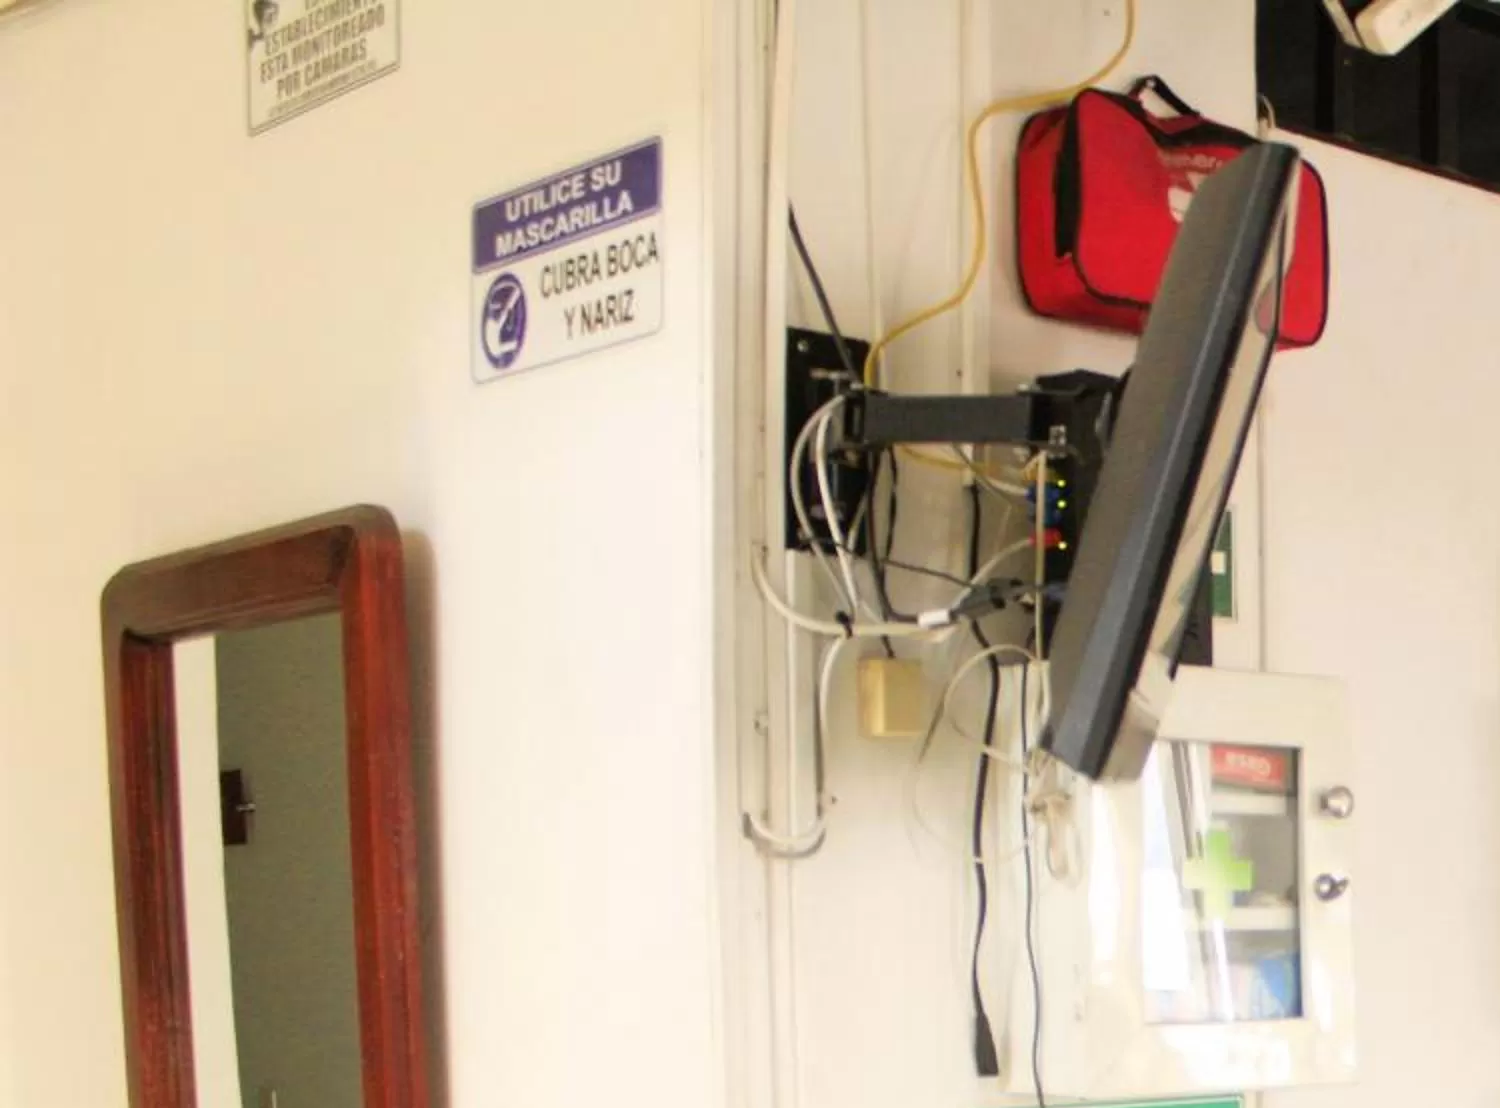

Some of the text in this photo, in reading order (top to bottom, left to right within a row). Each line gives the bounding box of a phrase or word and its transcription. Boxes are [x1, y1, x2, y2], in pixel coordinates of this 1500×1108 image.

[292, 3, 385, 65] MONITOREADO
[277, 70, 301, 99] POR
[304, 37, 367, 86] CAMARAS
[505, 161, 622, 222] UTILICE SU
[494, 190, 634, 258] MASCARILLA
[540, 232, 660, 300] CUBRA BOCA
[563, 289, 635, 341] Y NARIZ
